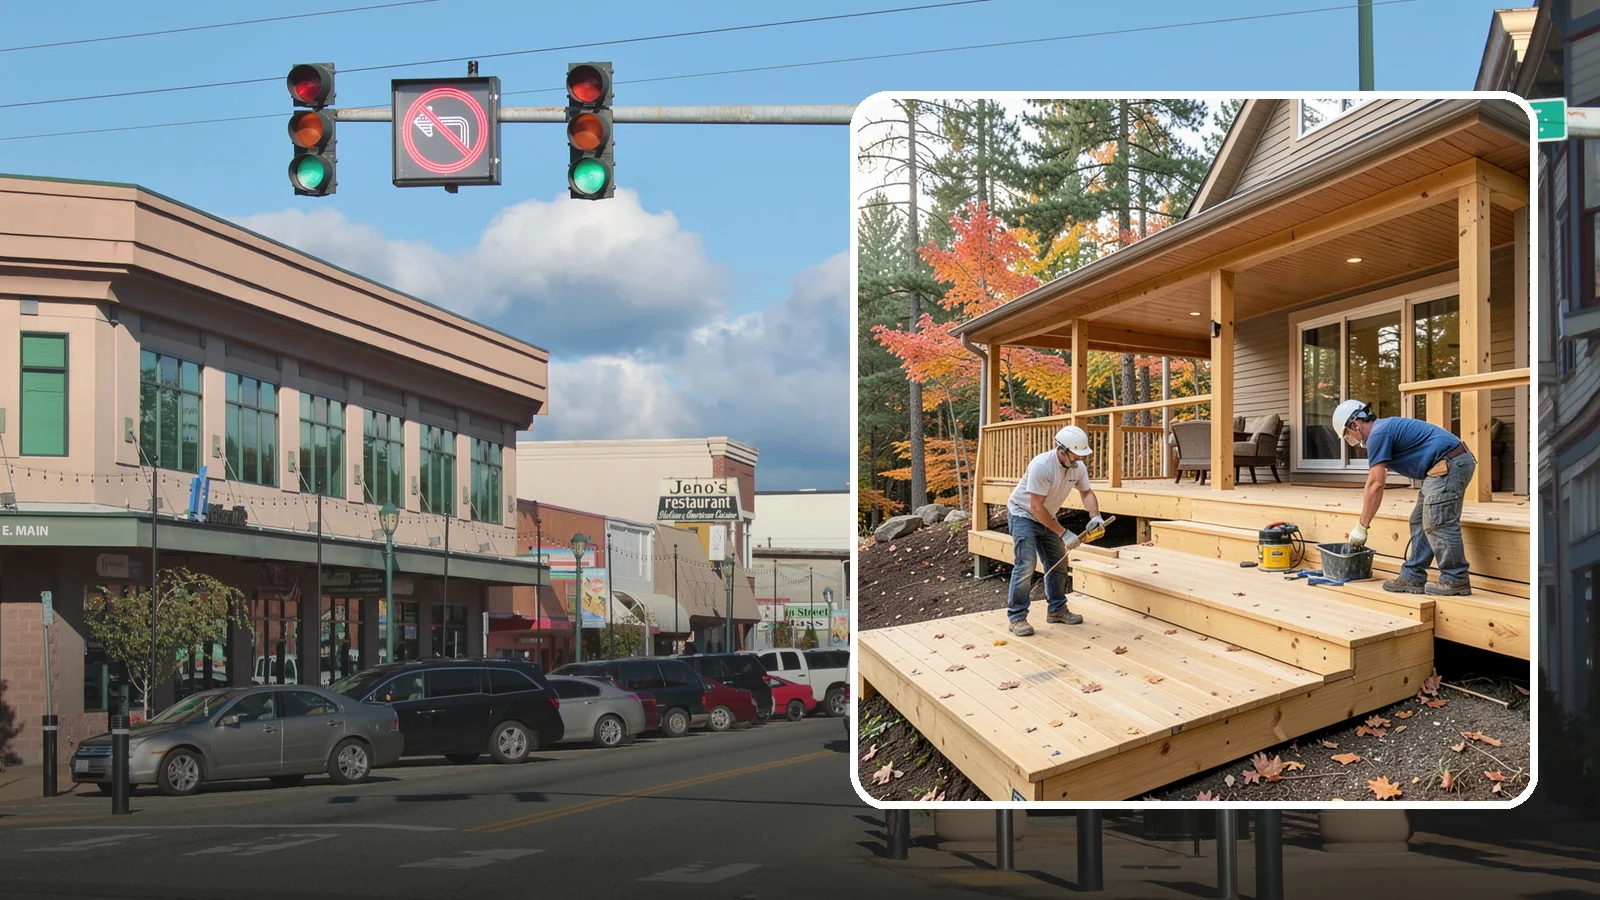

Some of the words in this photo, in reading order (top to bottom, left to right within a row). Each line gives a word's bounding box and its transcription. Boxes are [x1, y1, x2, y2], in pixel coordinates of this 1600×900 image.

[670, 480, 728, 494] Jeno's
[665, 496, 731, 509] restaurant
[2, 525, 13, 536] E.
[15, 525, 49, 536] MAIN
[797, 608, 828, 617] Street
